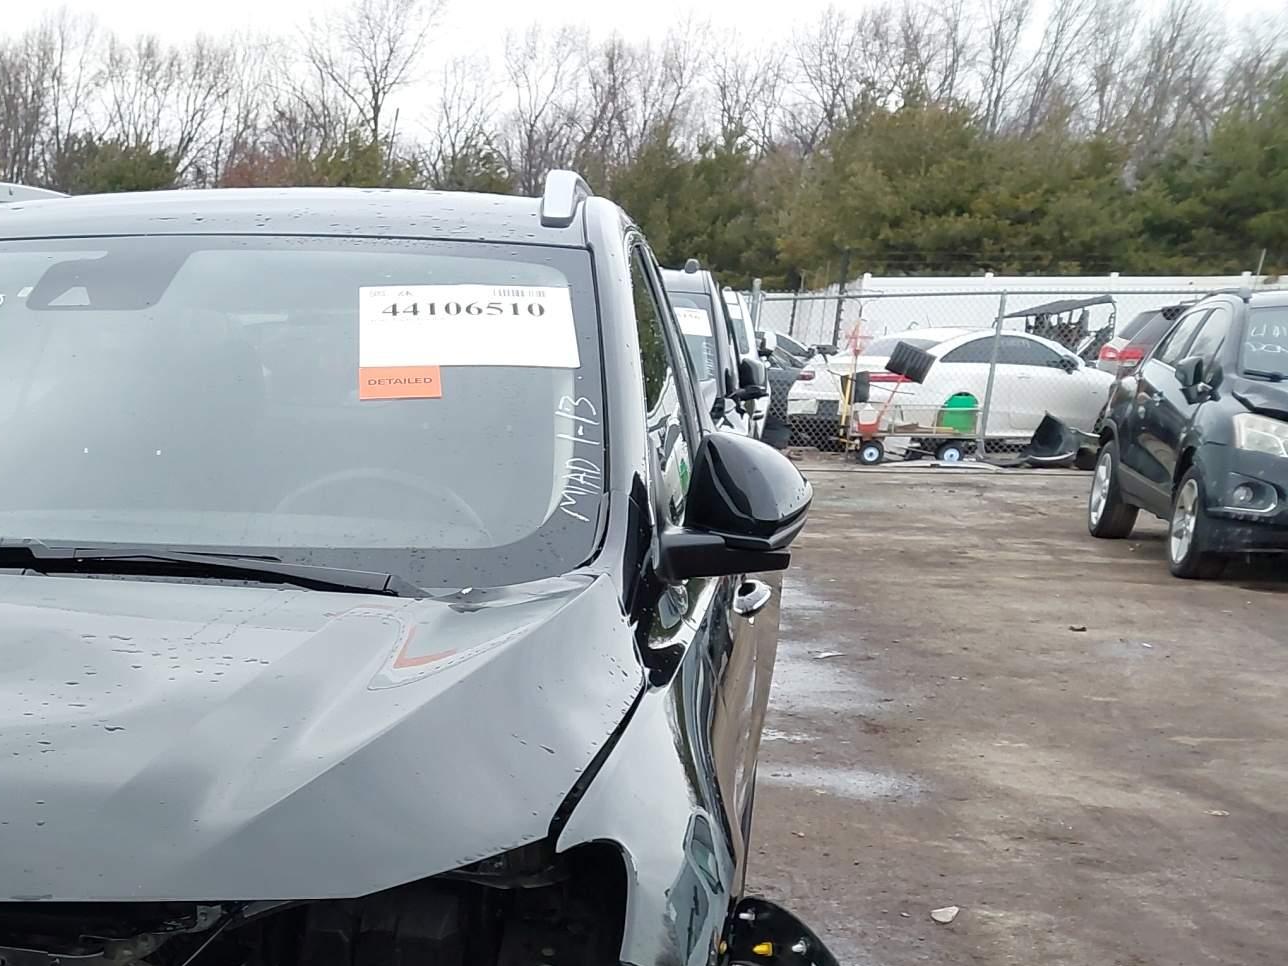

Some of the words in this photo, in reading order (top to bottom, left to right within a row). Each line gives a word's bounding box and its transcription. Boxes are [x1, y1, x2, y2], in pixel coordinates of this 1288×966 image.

[381, 301, 546, 318] 44106510
[367, 376, 433, 386] DETAILED
[554, 395, 601, 446] 1-13
